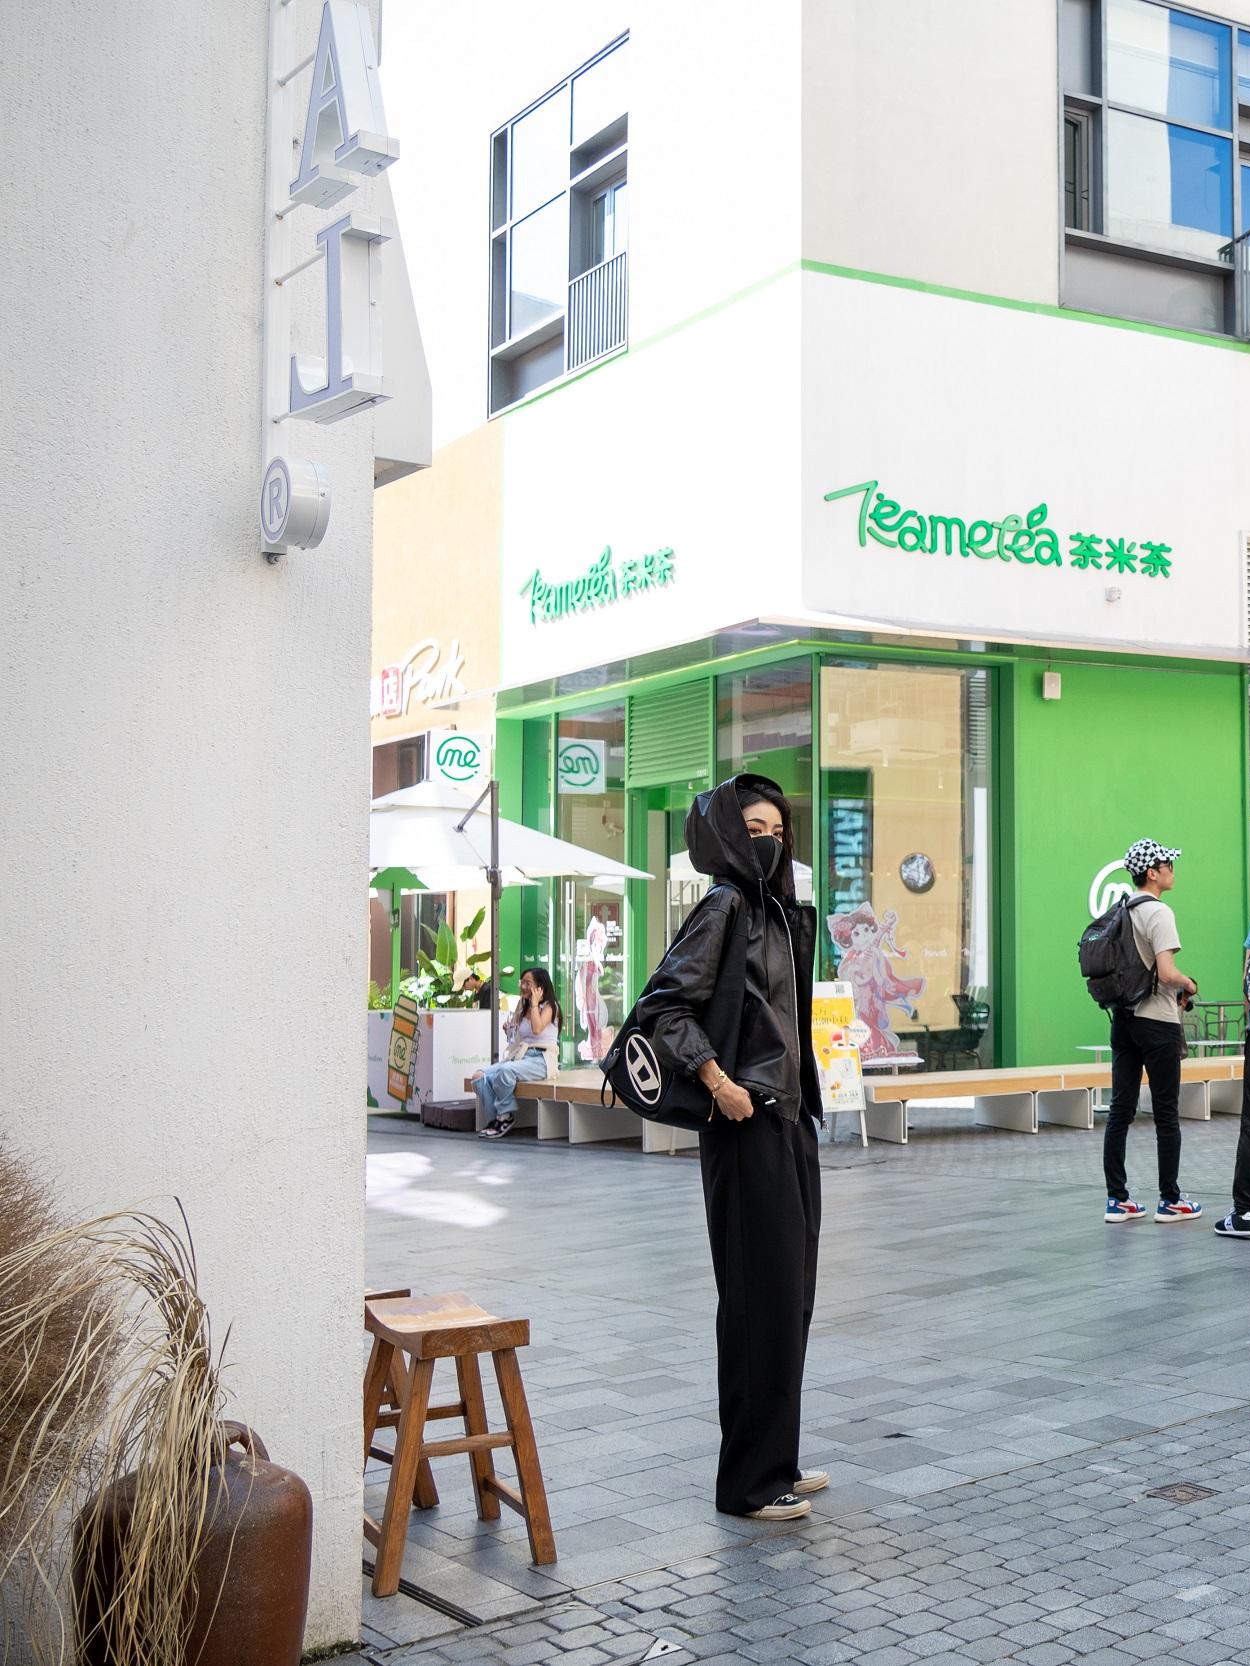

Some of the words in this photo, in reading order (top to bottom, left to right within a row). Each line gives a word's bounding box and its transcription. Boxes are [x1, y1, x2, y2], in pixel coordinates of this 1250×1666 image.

[619, 547, 676, 598] 茶米茶
[1069, 532, 1172, 578] 茶米茶
